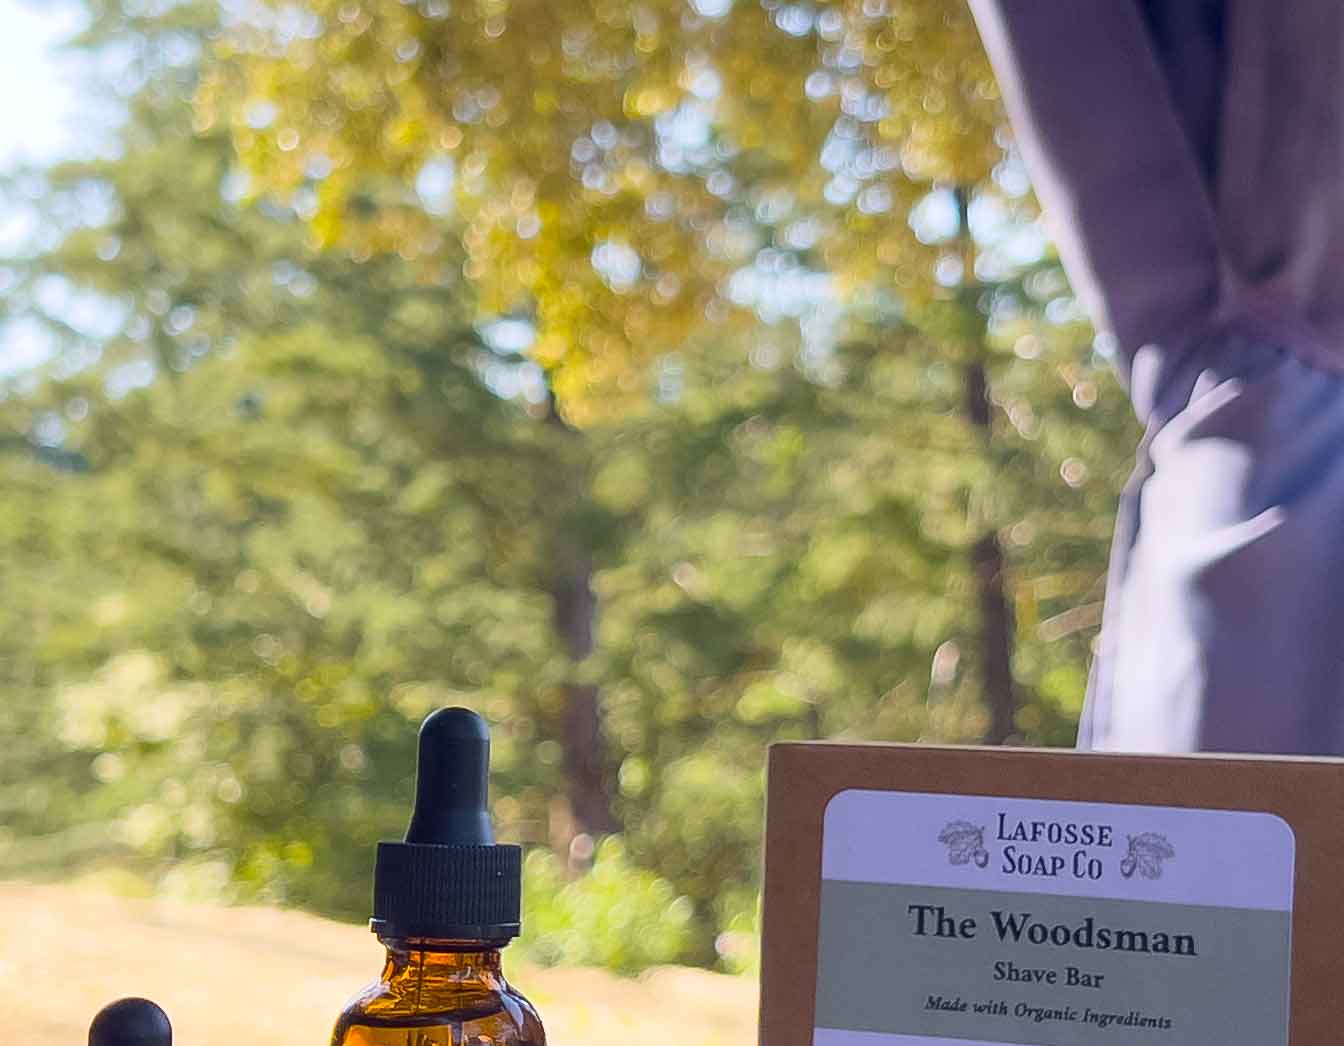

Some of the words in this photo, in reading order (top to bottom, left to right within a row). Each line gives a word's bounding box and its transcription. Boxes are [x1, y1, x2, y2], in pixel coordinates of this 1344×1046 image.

[908, 904, 978, 940] The
[989, 910, 1199, 957] Woodsman
[993, 961, 1057, 987] Shave
[1065, 967, 1105, 990] Bar
[924, 995, 969, 1013] Made
[973, 999, 1008, 1018] with
[1014, 1003, 1078, 1025] Organic
[1082, 1008, 1172, 1031] Ingredients
